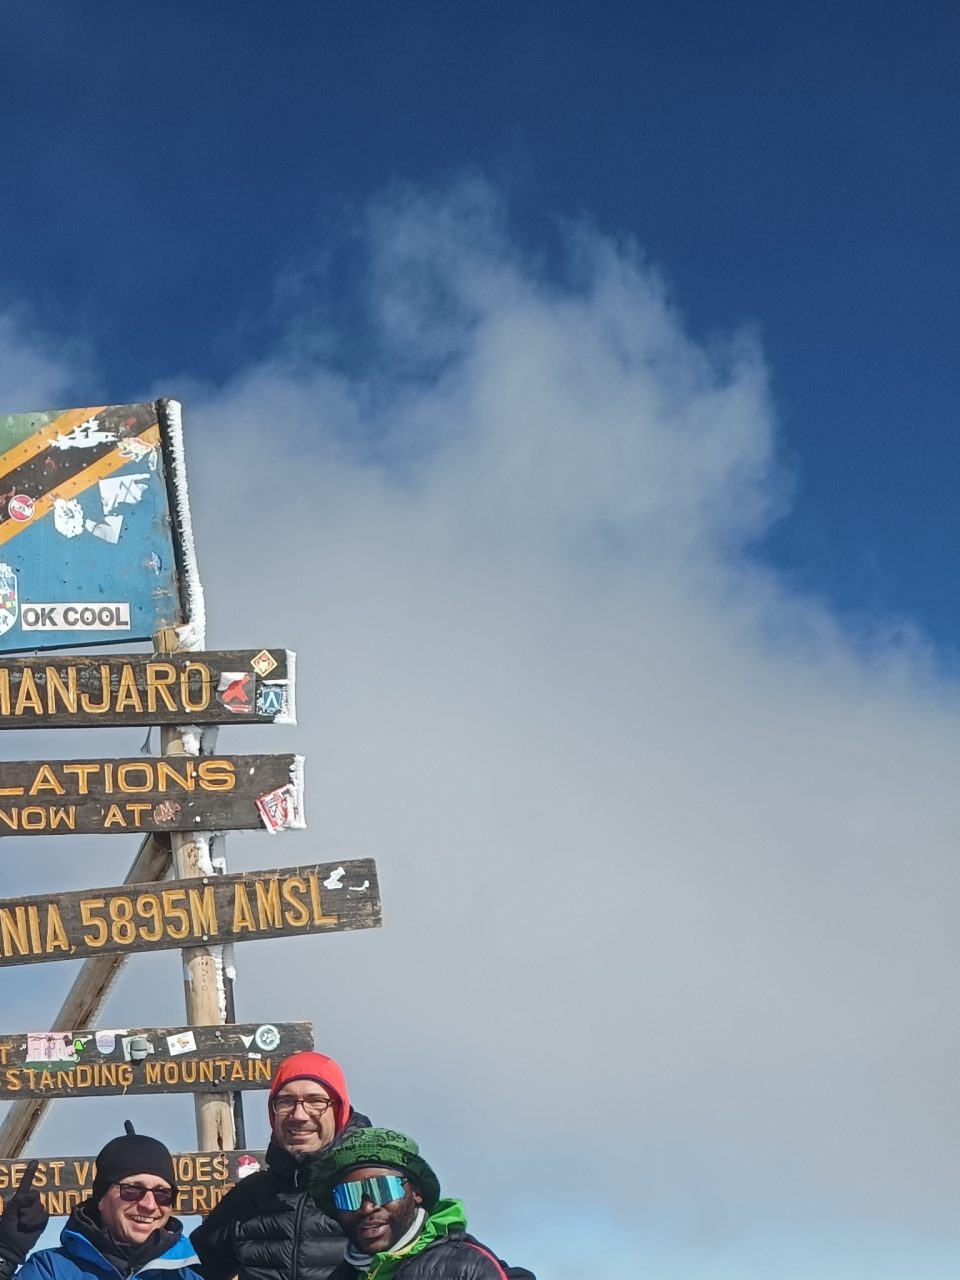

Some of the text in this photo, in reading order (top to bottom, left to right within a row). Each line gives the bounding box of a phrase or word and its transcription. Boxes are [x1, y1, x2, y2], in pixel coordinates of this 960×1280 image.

[22, 606, 129, 627] OK COOL
[104, 802, 151, 827] AT
[82, 885, 219, 947] 5895M
[233, 874, 338, 933] AMSL
[145, 1057, 272, 1086] MOUNTAIN
